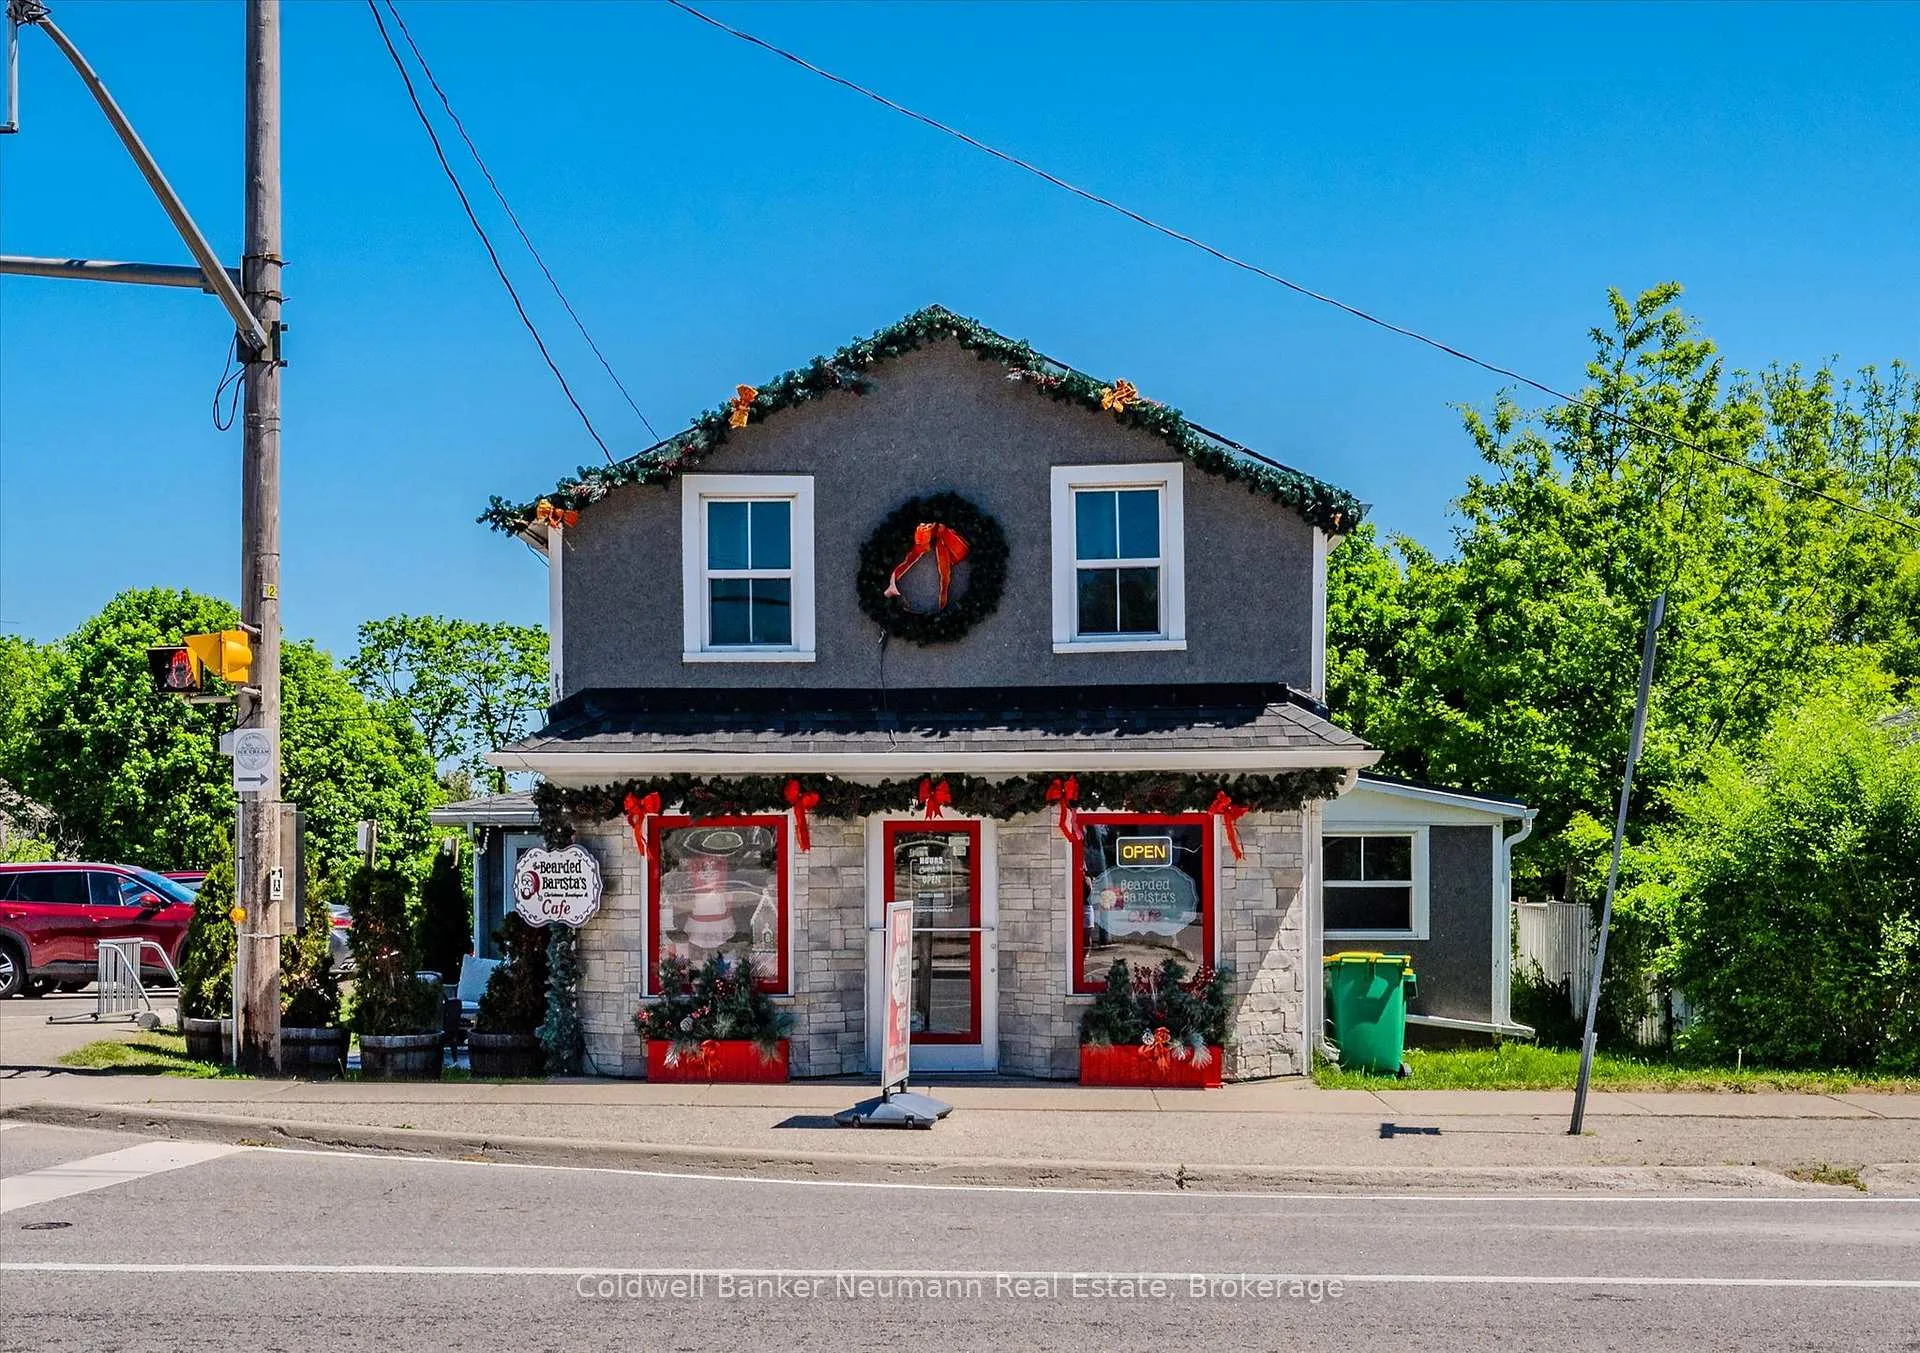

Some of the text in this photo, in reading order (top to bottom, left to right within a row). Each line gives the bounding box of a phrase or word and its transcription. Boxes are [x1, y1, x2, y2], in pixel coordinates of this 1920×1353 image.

[1122, 844, 1167, 859] OPEN
[540, 859, 582, 874] Bearded
[1120, 879, 1170, 891] Bearded
[1122, 891, 1176, 904] Barista's
[541, 898, 571, 919] Cafe
